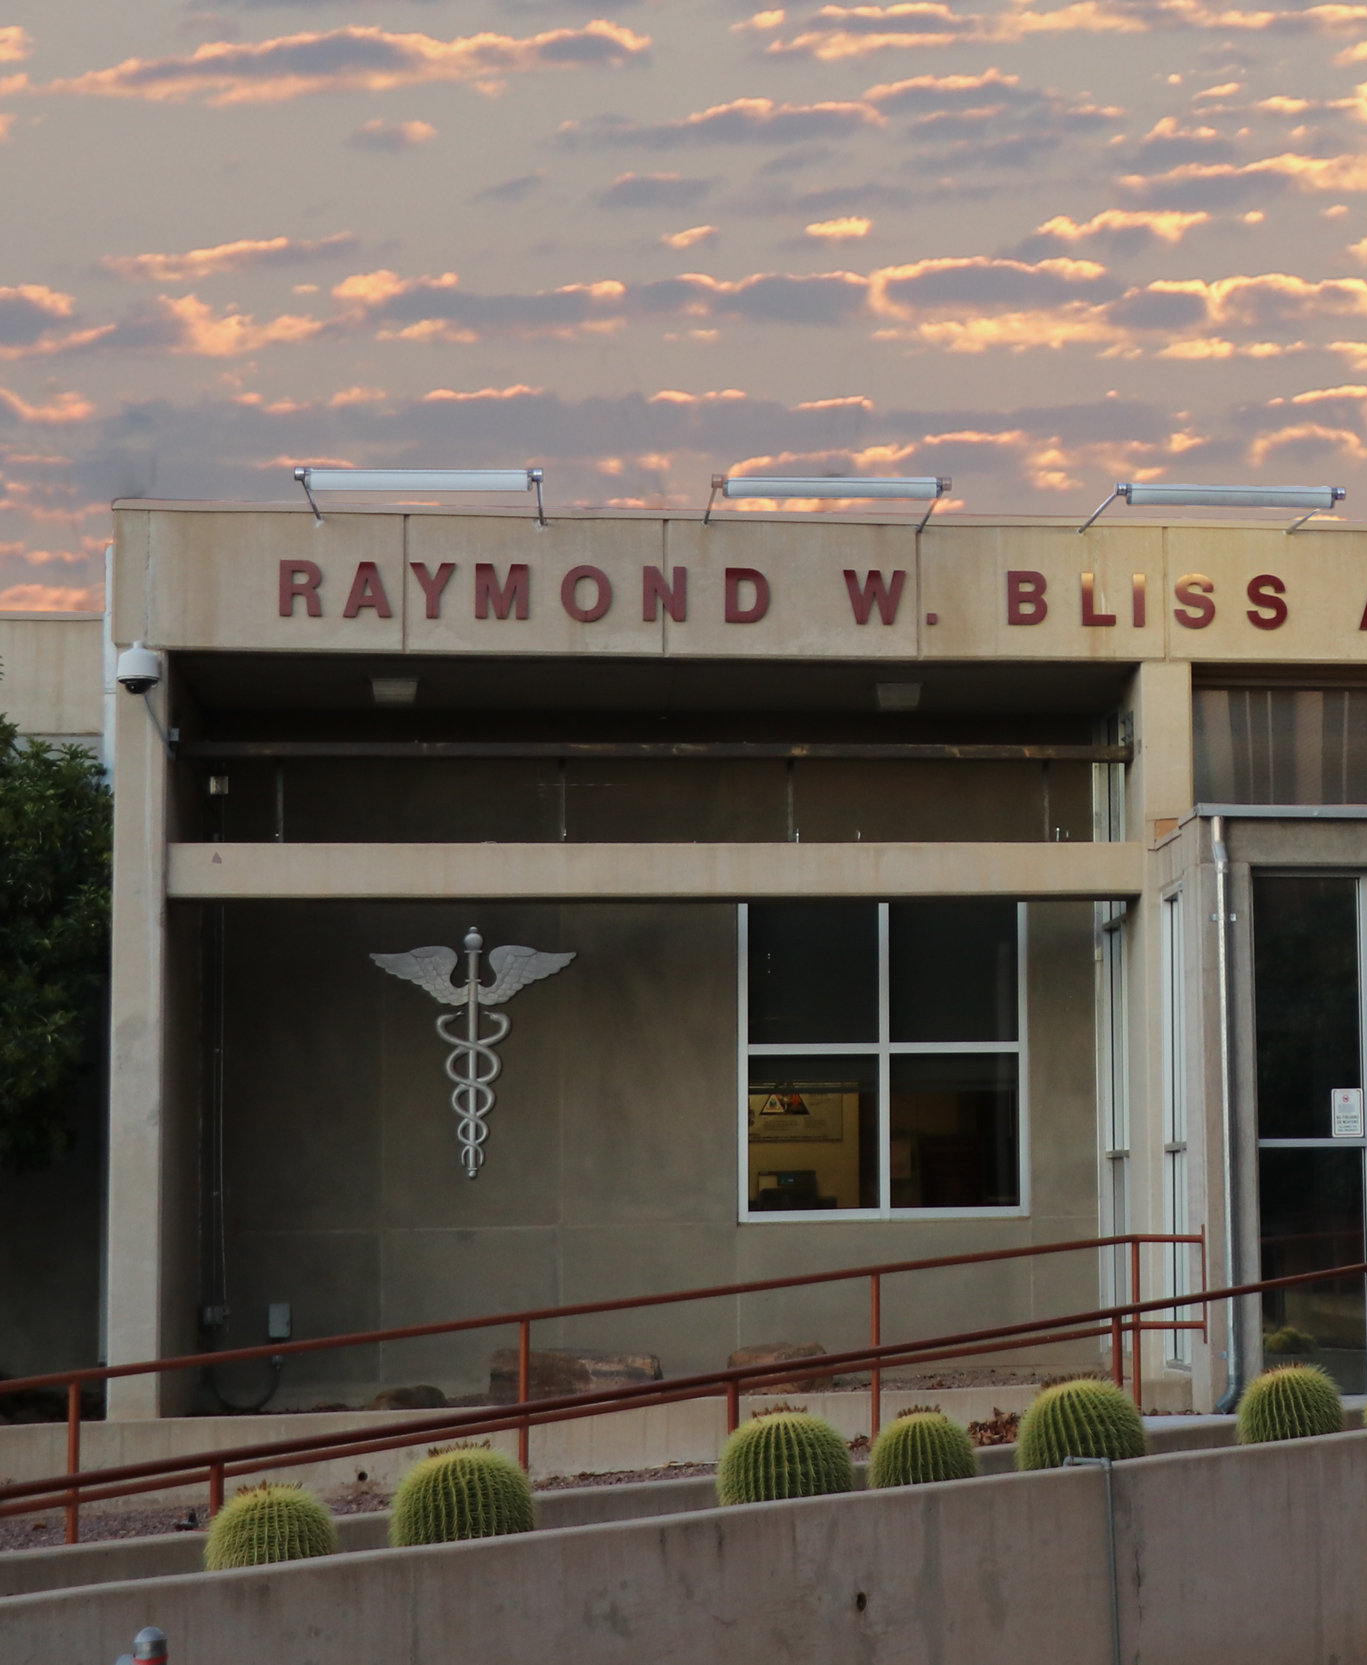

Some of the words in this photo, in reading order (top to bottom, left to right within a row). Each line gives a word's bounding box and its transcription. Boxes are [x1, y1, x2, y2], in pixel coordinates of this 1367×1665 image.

[279, 559, 771, 624] RAYMOND
[843, 569, 938, 626] W.
[1007, 570, 1289, 632] BLISS
